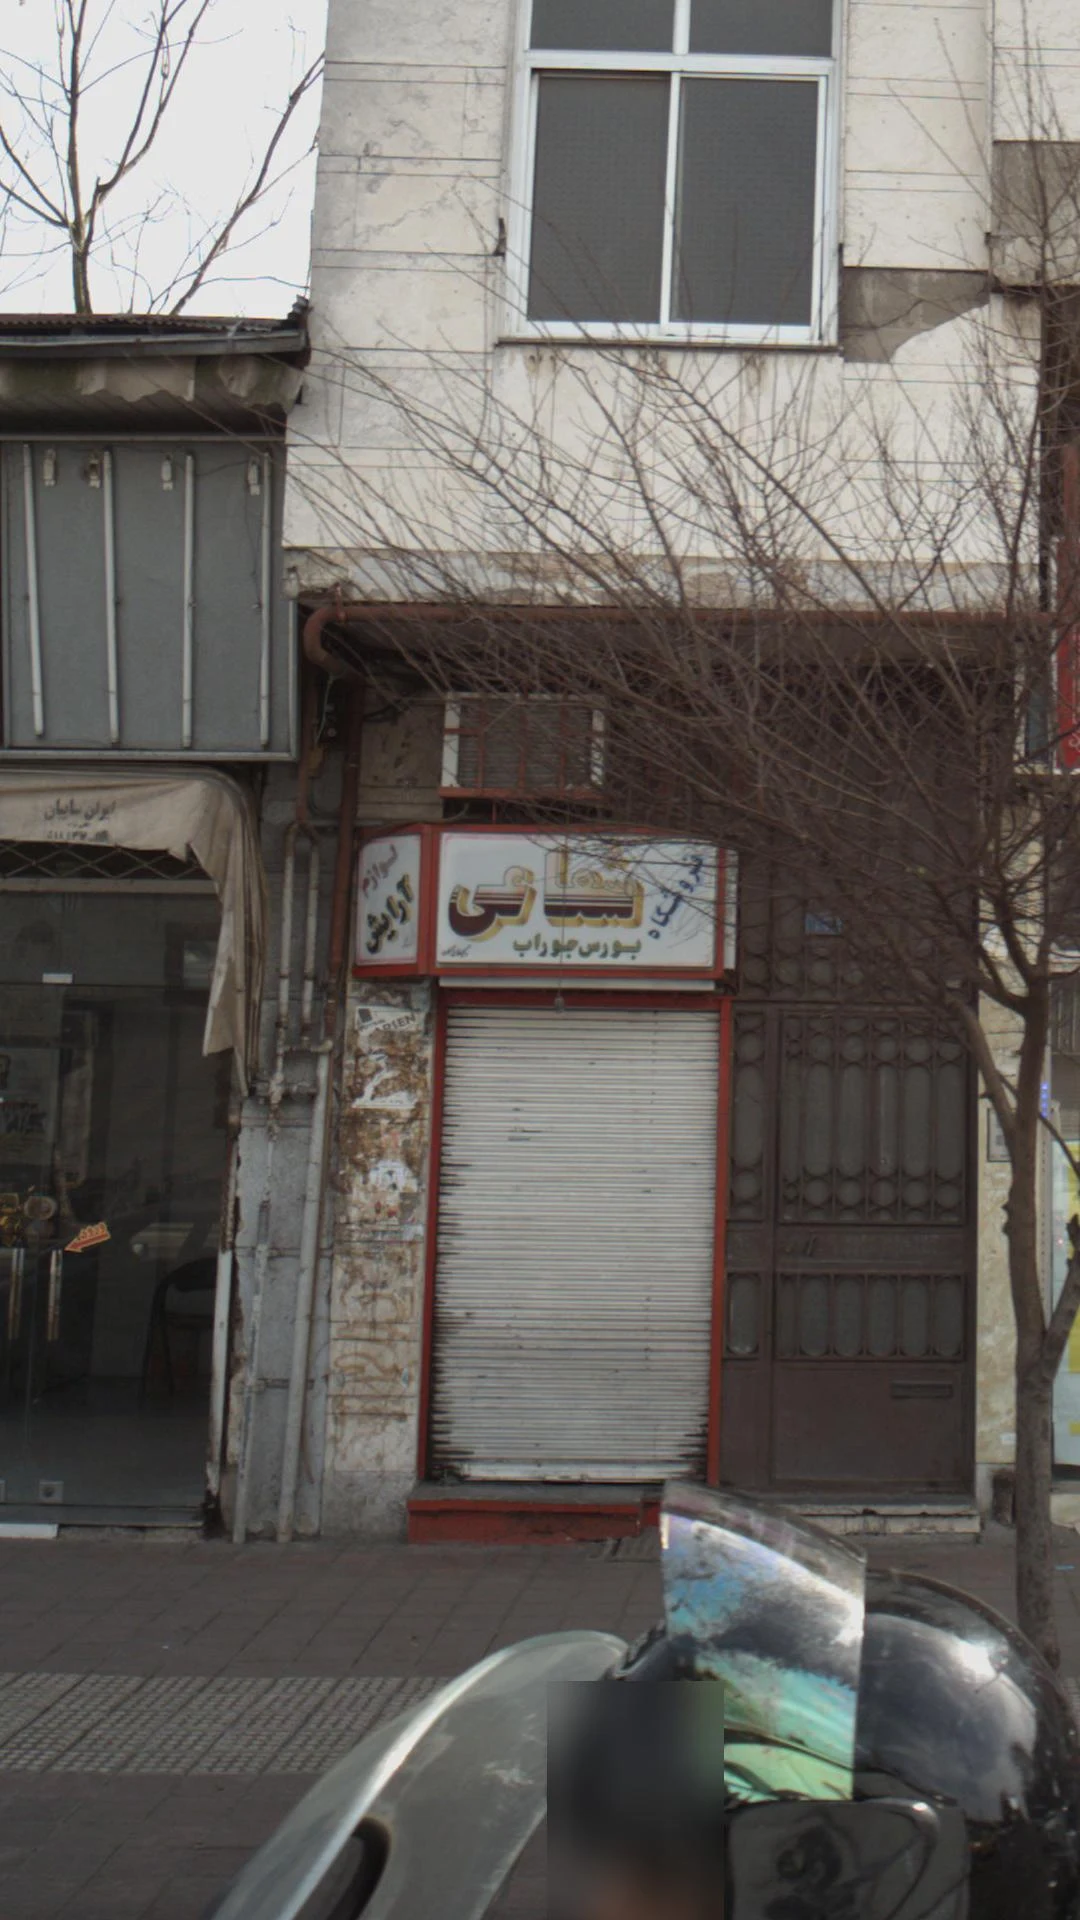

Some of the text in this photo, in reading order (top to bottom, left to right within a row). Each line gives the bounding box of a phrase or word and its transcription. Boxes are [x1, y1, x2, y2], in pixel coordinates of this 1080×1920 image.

[365, 872, 414, 955] آرایش
[648, 853, 704, 940] فروشگاه
[512, 932, 642, 960] بورس جوراب
